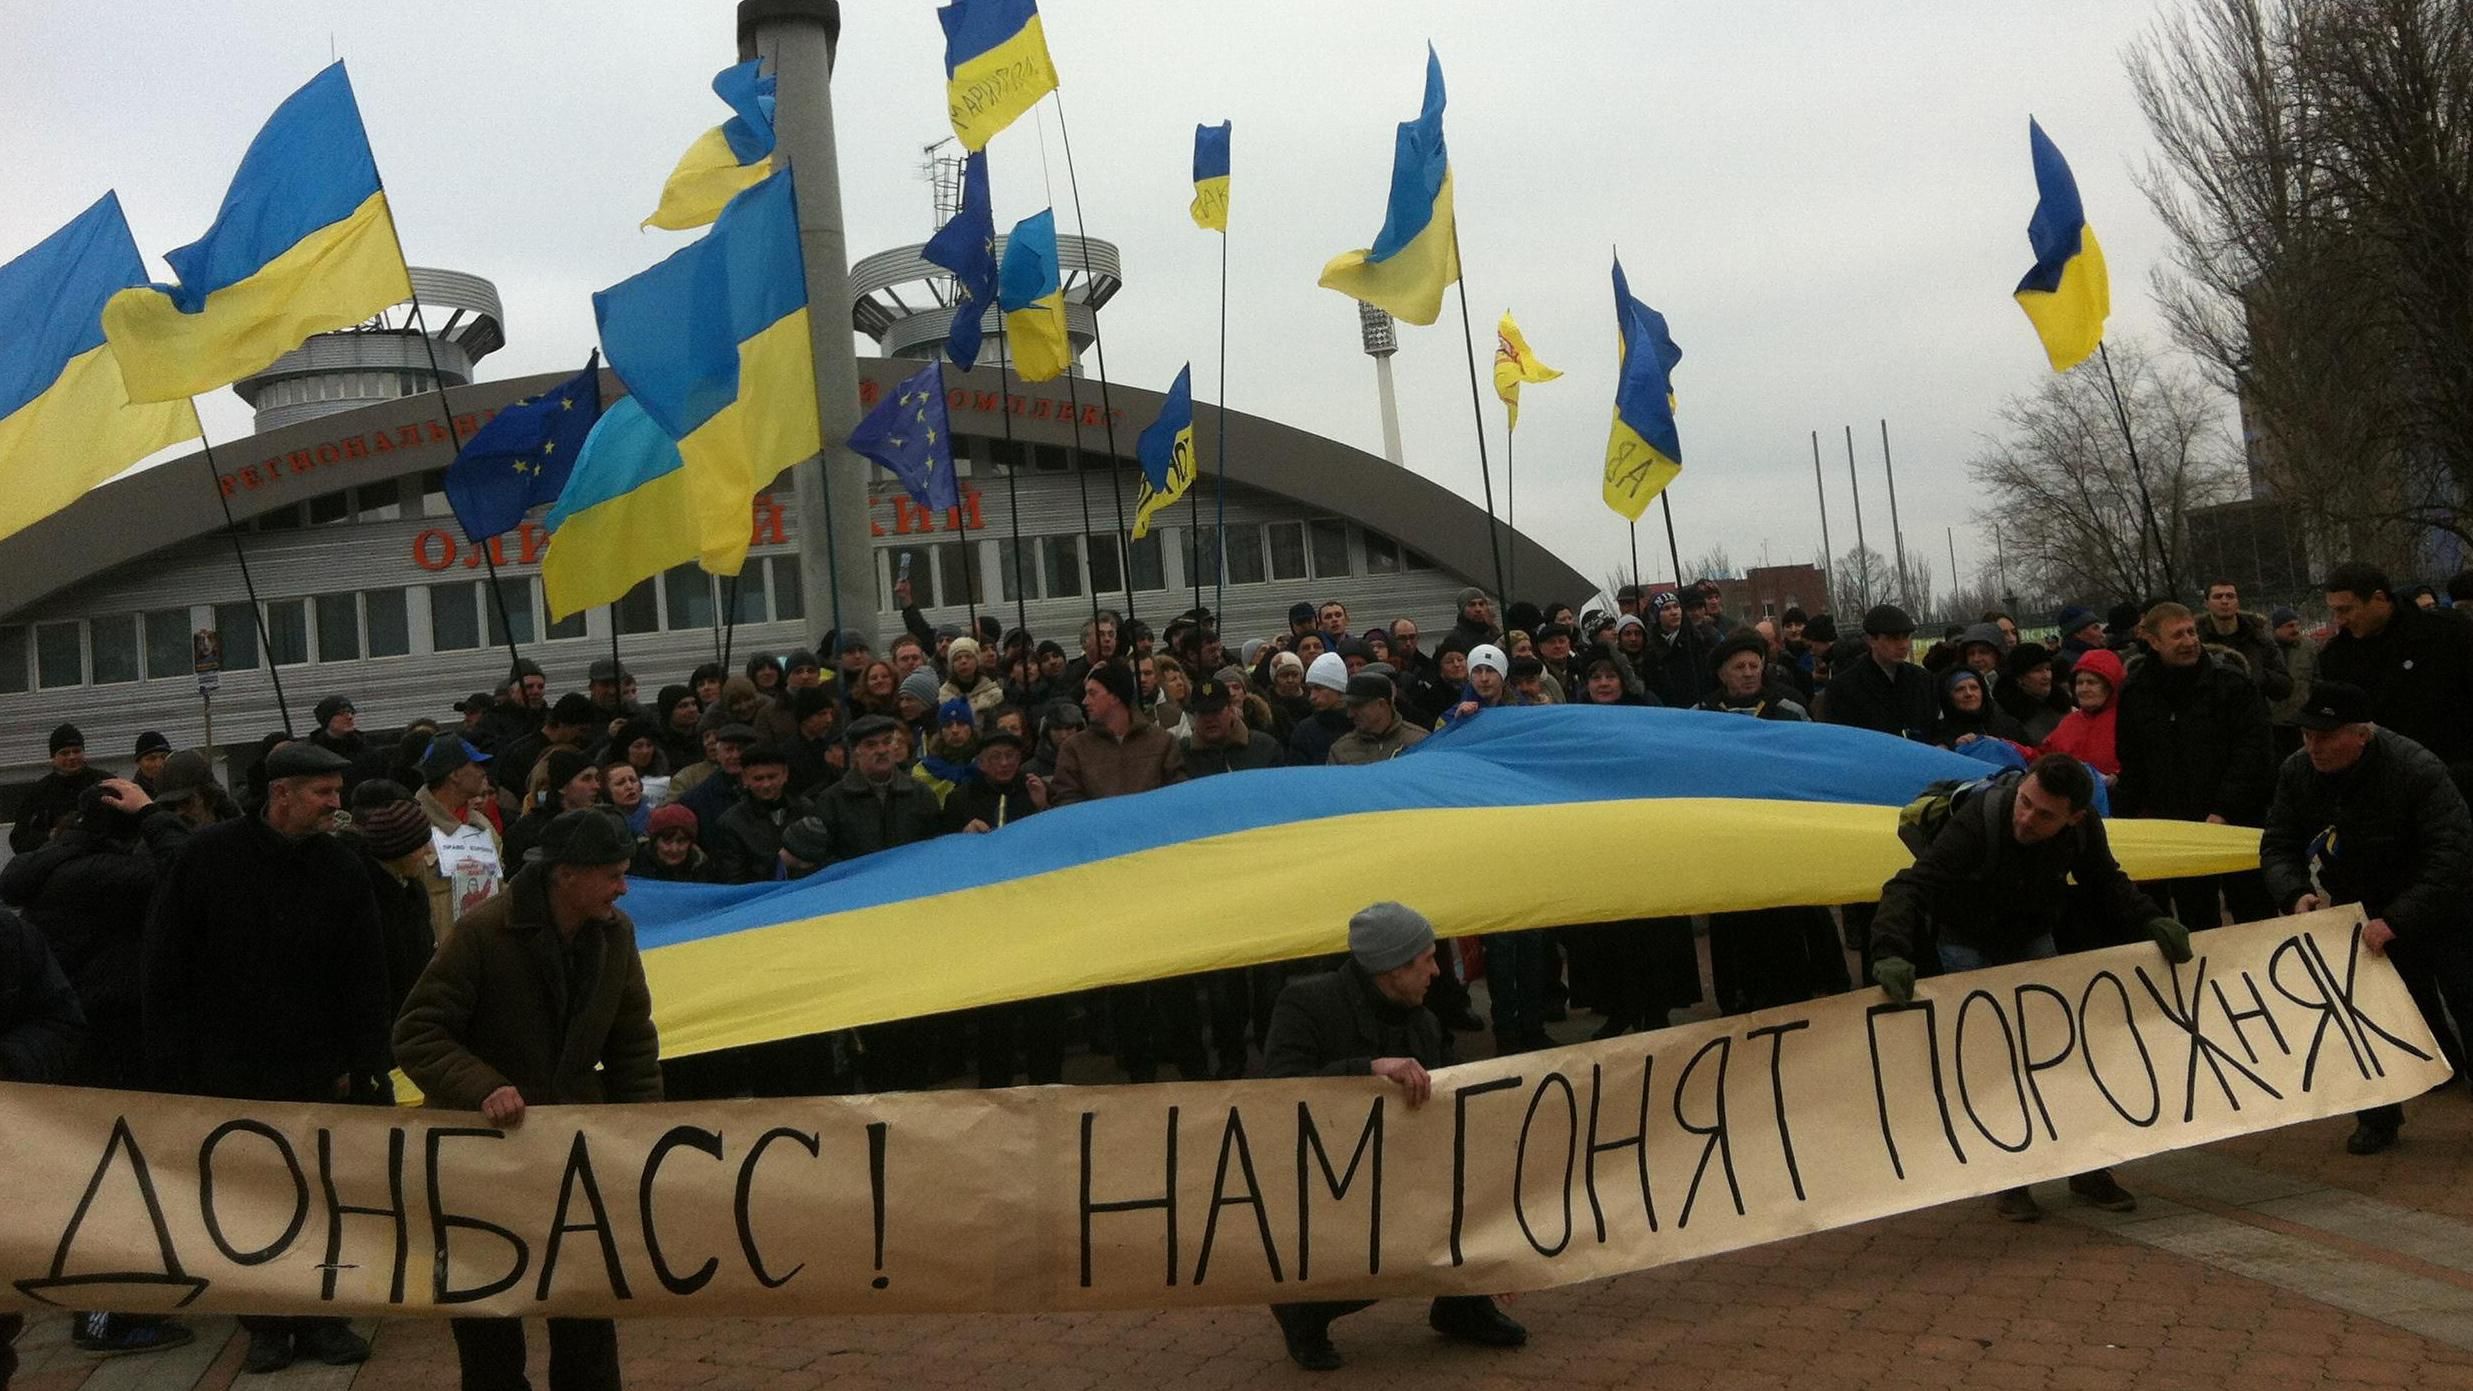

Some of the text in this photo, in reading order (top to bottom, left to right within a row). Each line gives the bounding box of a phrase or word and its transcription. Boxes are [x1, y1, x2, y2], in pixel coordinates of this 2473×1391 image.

[950, 55, 1039, 130] МАРИУПОЛ
[945, 386, 1128, 427] ОМПЛЕКС
[218, 408, 497, 499] РЕГИОНАЛЬН
[13, 922, 2433, 1307] ДОНБАСС! НАМ ГОНЯТ ПОРОЖНЯК
